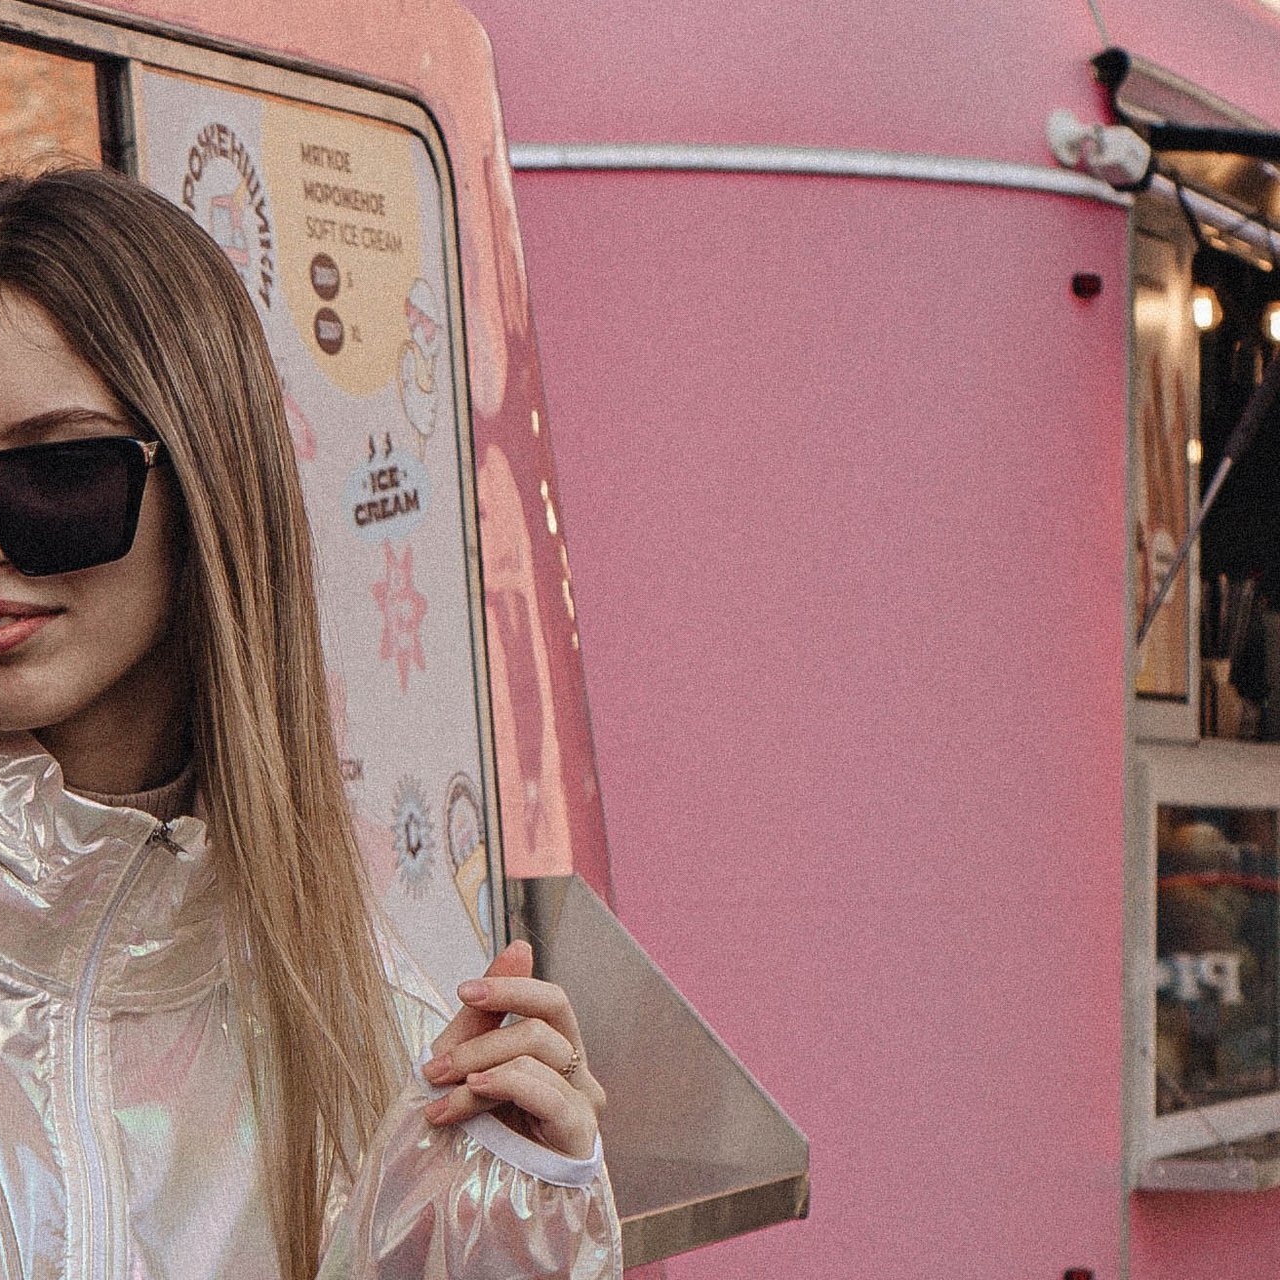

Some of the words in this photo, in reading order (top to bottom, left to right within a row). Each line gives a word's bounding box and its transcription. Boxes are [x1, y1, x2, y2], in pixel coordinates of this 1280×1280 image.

[302, 179, 386, 216] МОРОЖЕНОЕ
[339, 222, 359, 248] ICE
[361, 226, 403, 254] CREAM
[370, 466, 400, 495] ICE
[354, 488, 420, 528] CREAM
